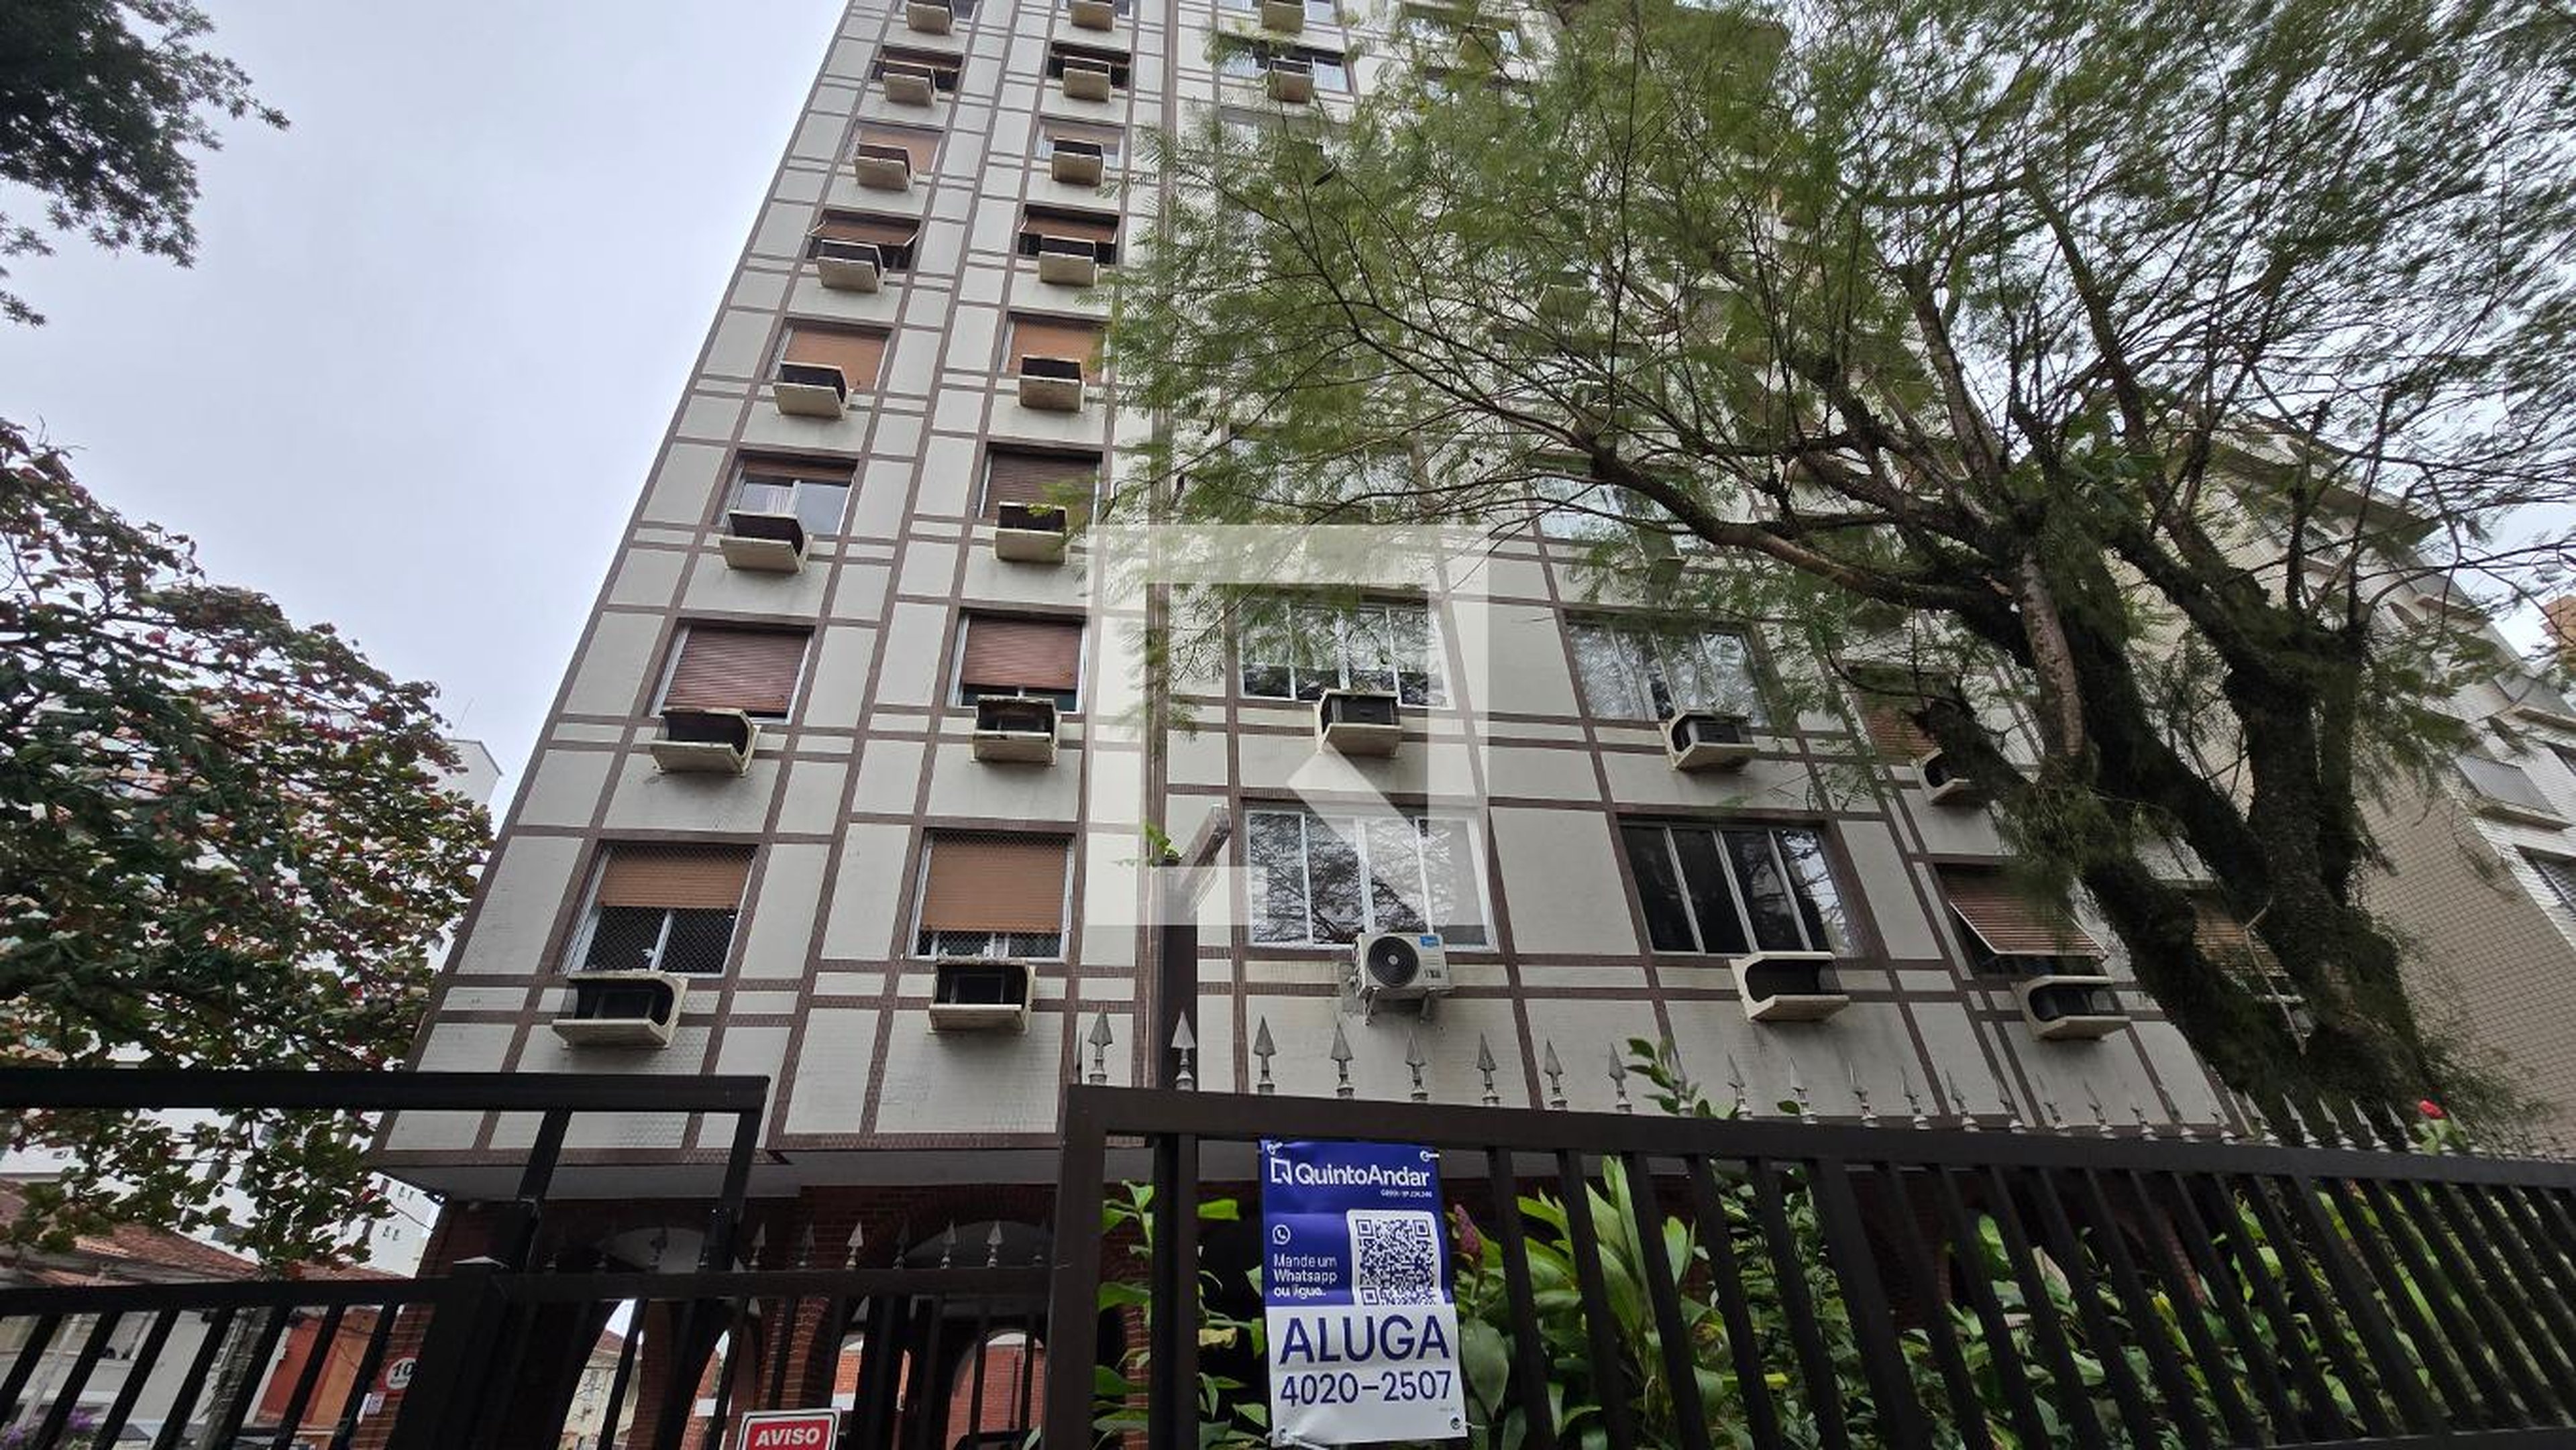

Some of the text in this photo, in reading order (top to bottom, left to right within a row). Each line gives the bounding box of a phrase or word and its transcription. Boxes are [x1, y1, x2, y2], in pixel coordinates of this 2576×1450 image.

[1295, 1163, 1430, 1186] QuintoAndar
[1274, 1253, 1338, 1268] Mande um
[1273, 1269, 1338, 1285] Whatsapp
[1274, 1284, 1327, 1300] ou ligue.
[1279, 1315, 1450, 1365] ALUGA
[1280, 1370, 1452, 1407] 4020-2507
[755, 1427, 820, 1447] AVISO
